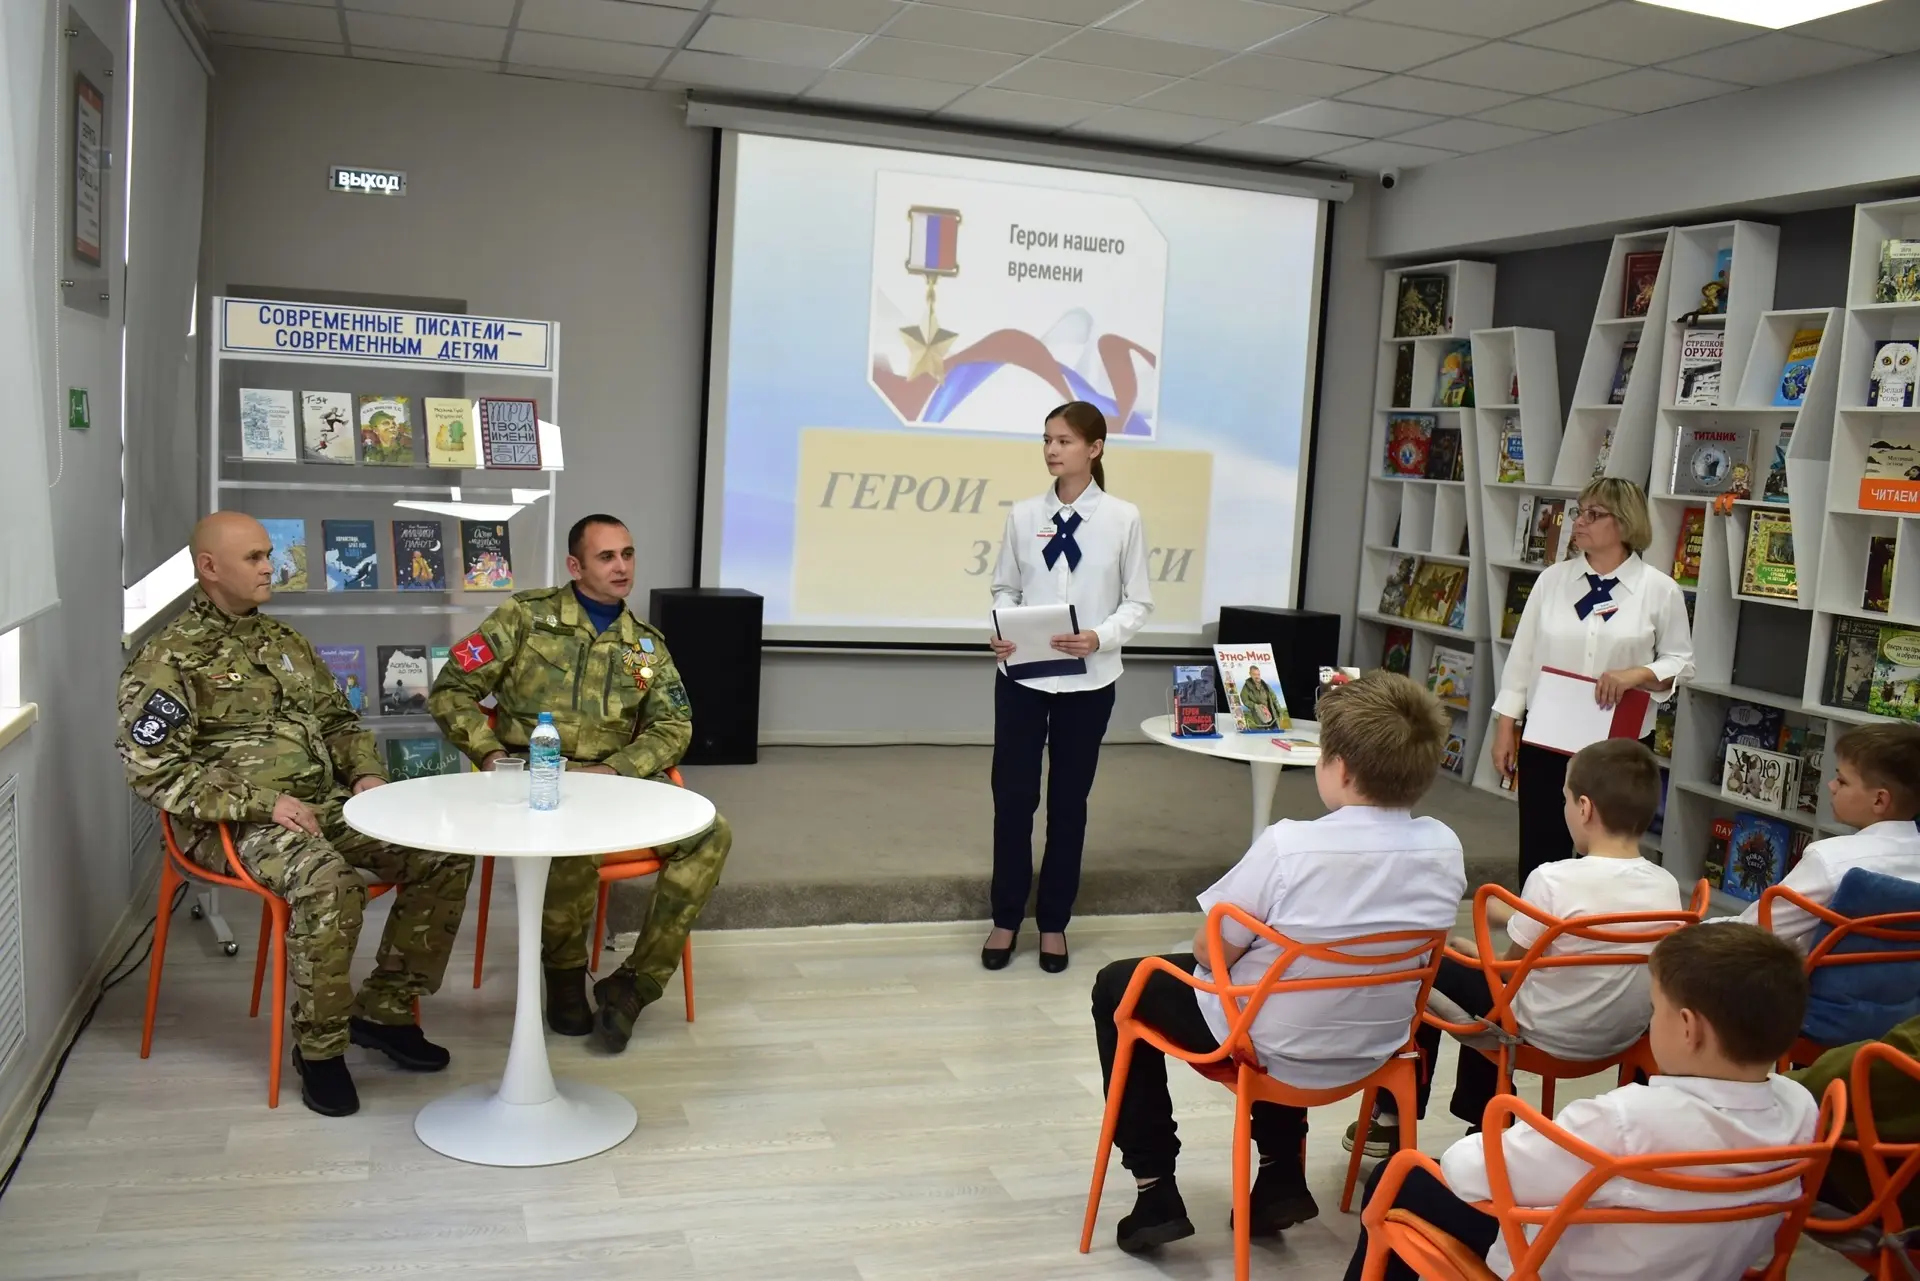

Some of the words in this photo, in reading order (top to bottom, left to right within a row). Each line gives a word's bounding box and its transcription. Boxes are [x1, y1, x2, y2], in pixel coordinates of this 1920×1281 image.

[338, 171, 400, 191] ВЫХОД
[1009, 223, 1059, 251] Герои
[1063, 233, 1125, 255] нашего
[1007, 260, 1084, 282] времени
[275, 329, 422, 356] СОВРЕМЕННЫМ
[437, 341, 499, 361] ДЕТЯМ
[490, 422, 534, 432] ТВОИХ
[491, 432, 535, 442] ИМЕНИ
[1694, 431, 1737, 442] ТИТАНИК
[818, 471, 992, 514] ГЕРОИ
[1870, 488, 1918, 503] ЧИТАЕМ
[1218, 651, 1271, 663] Этно-Мир
